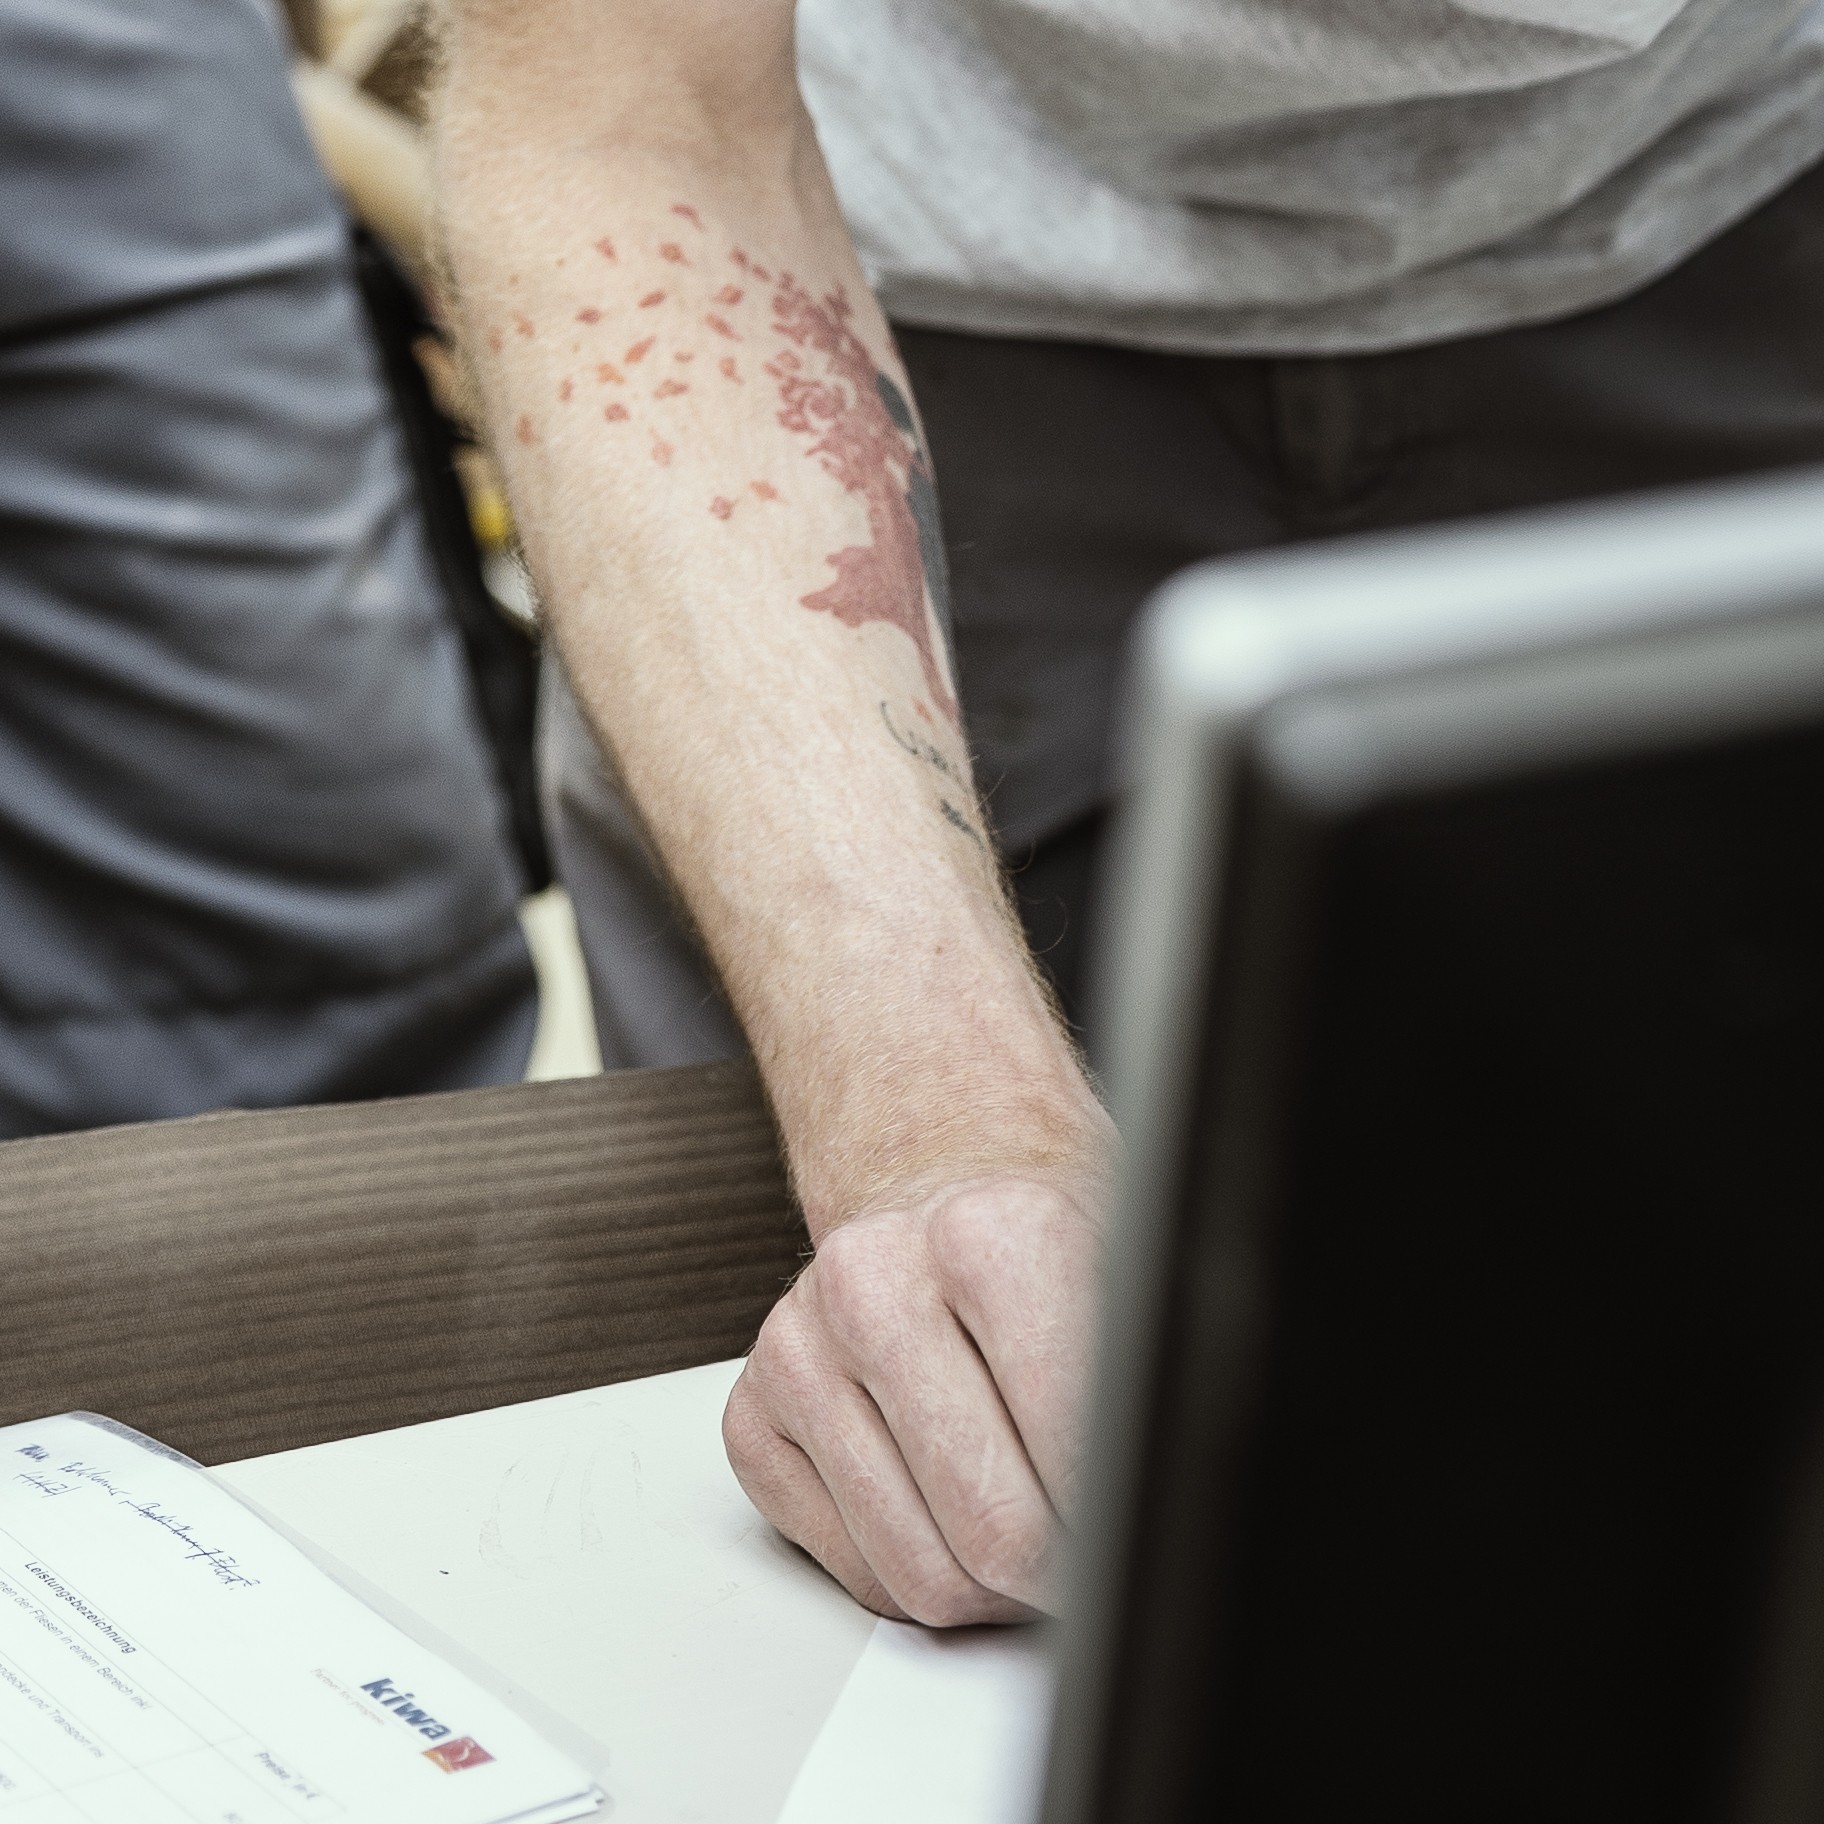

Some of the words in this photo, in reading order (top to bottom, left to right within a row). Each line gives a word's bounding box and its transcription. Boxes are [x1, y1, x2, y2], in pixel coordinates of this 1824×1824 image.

[15, 1596, 33, 1609] der
[30, 1609, 65, 1636] Fliesen
[61, 1635, 74, 1644] in
[70, 1644, 99, 1668] einem
[97, 1666, 135, 1696] Bereich
[24, 1561, 137, 1654] Leistungsbezeichnung
[28, 1693, 50, 1710] und
[360, 1677, 452, 1741] kiwa
